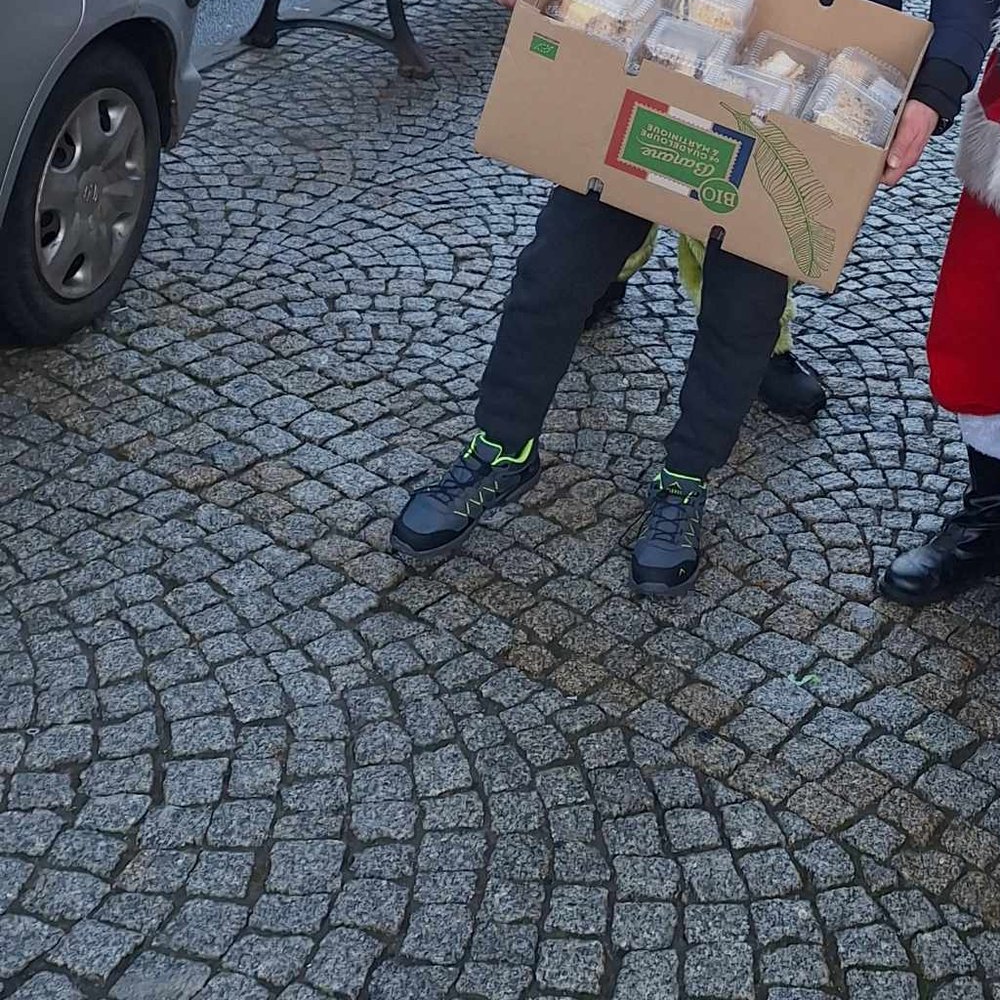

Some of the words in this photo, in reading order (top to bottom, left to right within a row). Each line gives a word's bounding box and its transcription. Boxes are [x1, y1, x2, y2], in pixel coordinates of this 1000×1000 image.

[646, 122, 711, 152] MARTINIQUE
[640, 145, 716, 178] Banane
[701, 186, 737, 208] BIO
